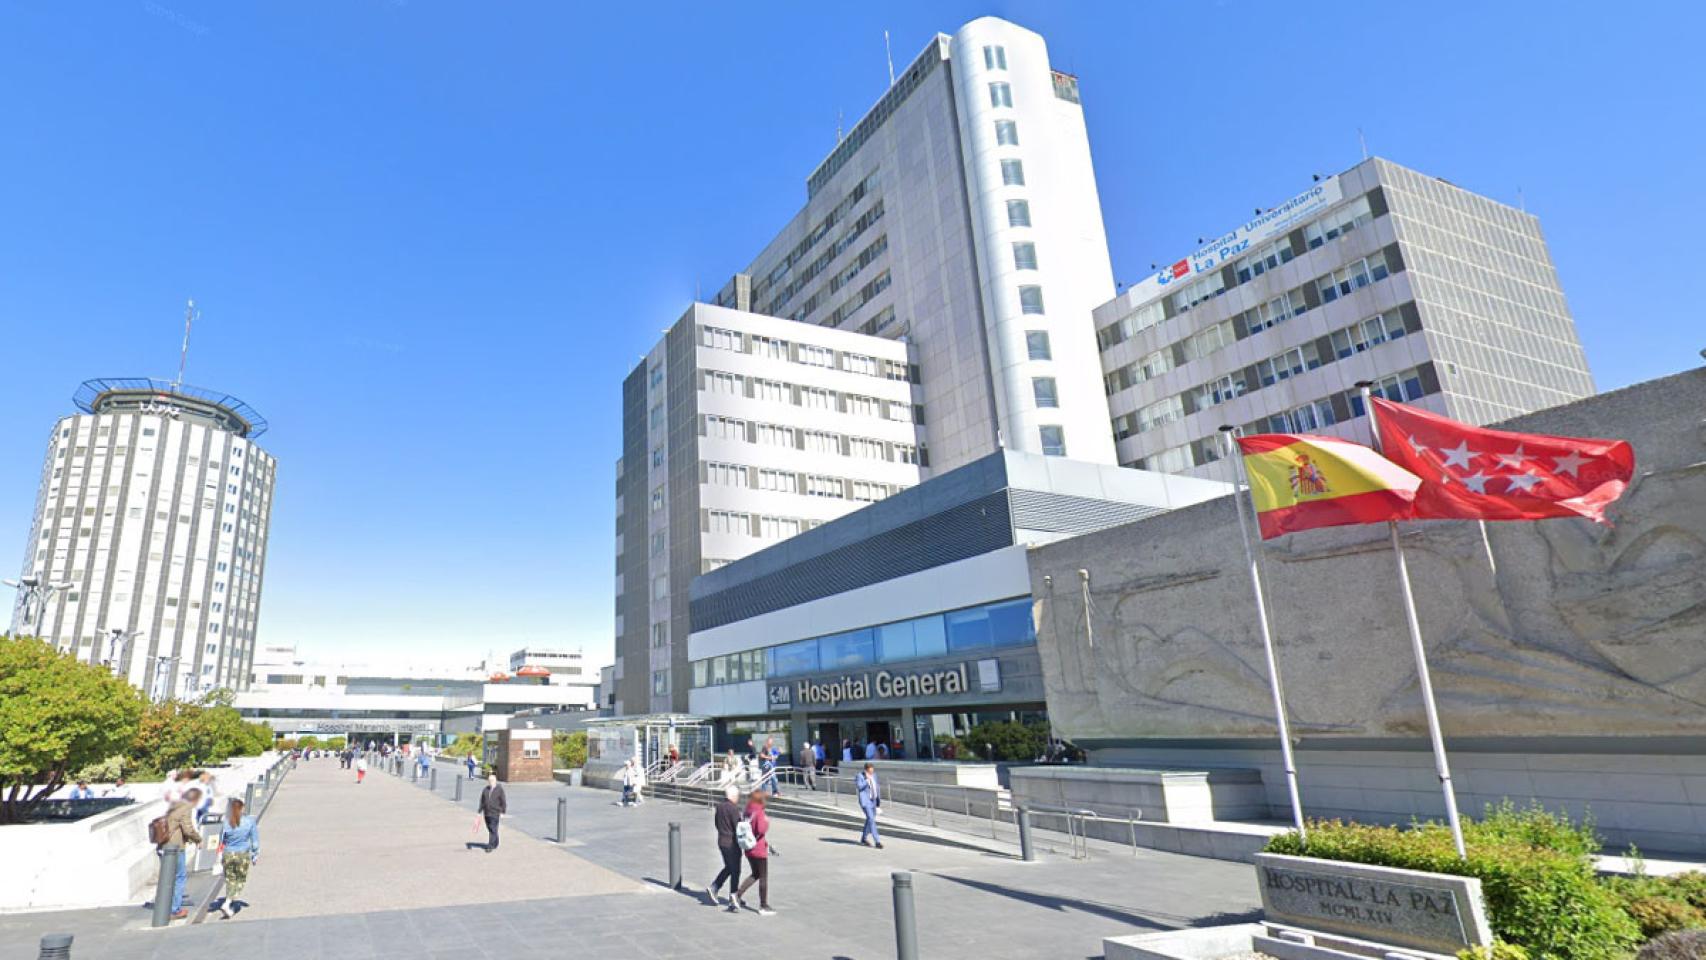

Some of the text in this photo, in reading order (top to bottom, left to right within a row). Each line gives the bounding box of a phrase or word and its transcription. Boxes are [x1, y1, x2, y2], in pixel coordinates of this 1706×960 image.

[1193, 231, 1237, 260] Hospital
[1244, 185, 1323, 232] Universitario
[1195, 238, 1249, 273] La Paz
[797, 661, 968, 708] Hospital General
[1265, 867, 1456, 916] HOSPITAL LA PAZ
[1320, 902, 1393, 924] MCMLXIV
